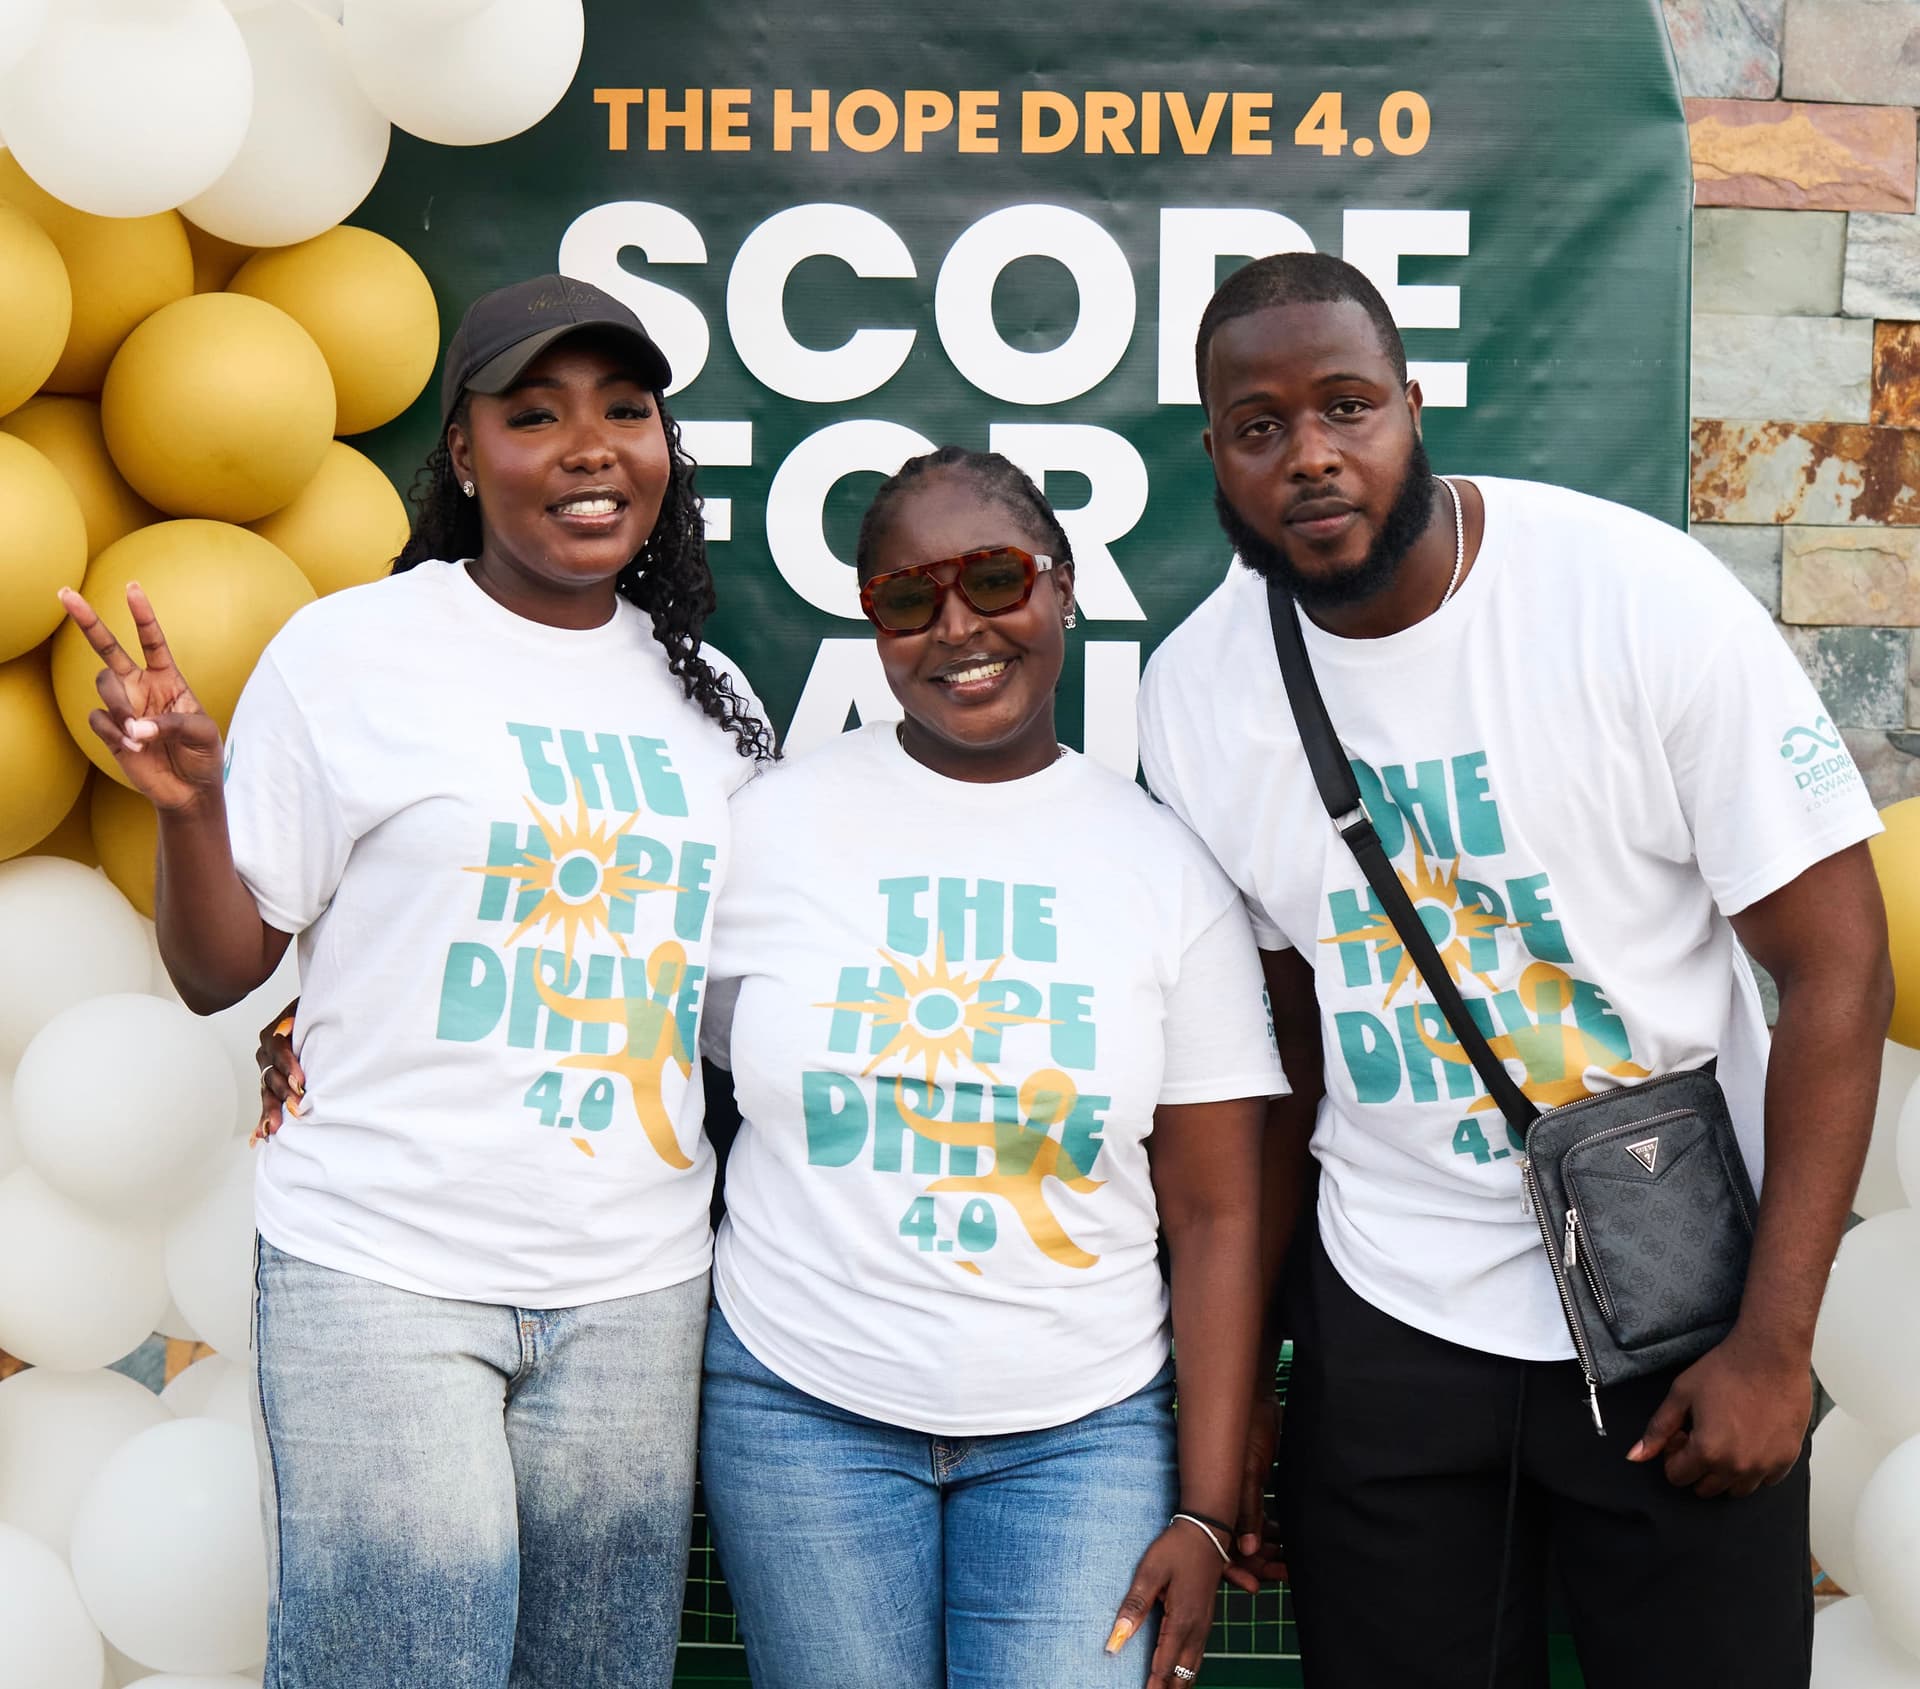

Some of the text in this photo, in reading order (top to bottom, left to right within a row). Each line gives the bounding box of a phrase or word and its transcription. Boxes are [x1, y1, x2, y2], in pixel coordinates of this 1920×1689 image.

[594, 88, 1431, 157] THE HOPE DRIVE 4.0
[557, 200, 1470, 407] SCOPE
[506, 722, 689, 817] THE
[477, 821, 717, 942] HOPE
[878, 876, 1057, 963] THE
[436, 942, 705, 1063] DRIVE
[827, 967, 1097, 1070] HOPE
[523, 1070, 615, 1131] 4.0
[802, 1071, 1111, 1181] DRIVE
[898, 1196, 998, 1252] 4.0
